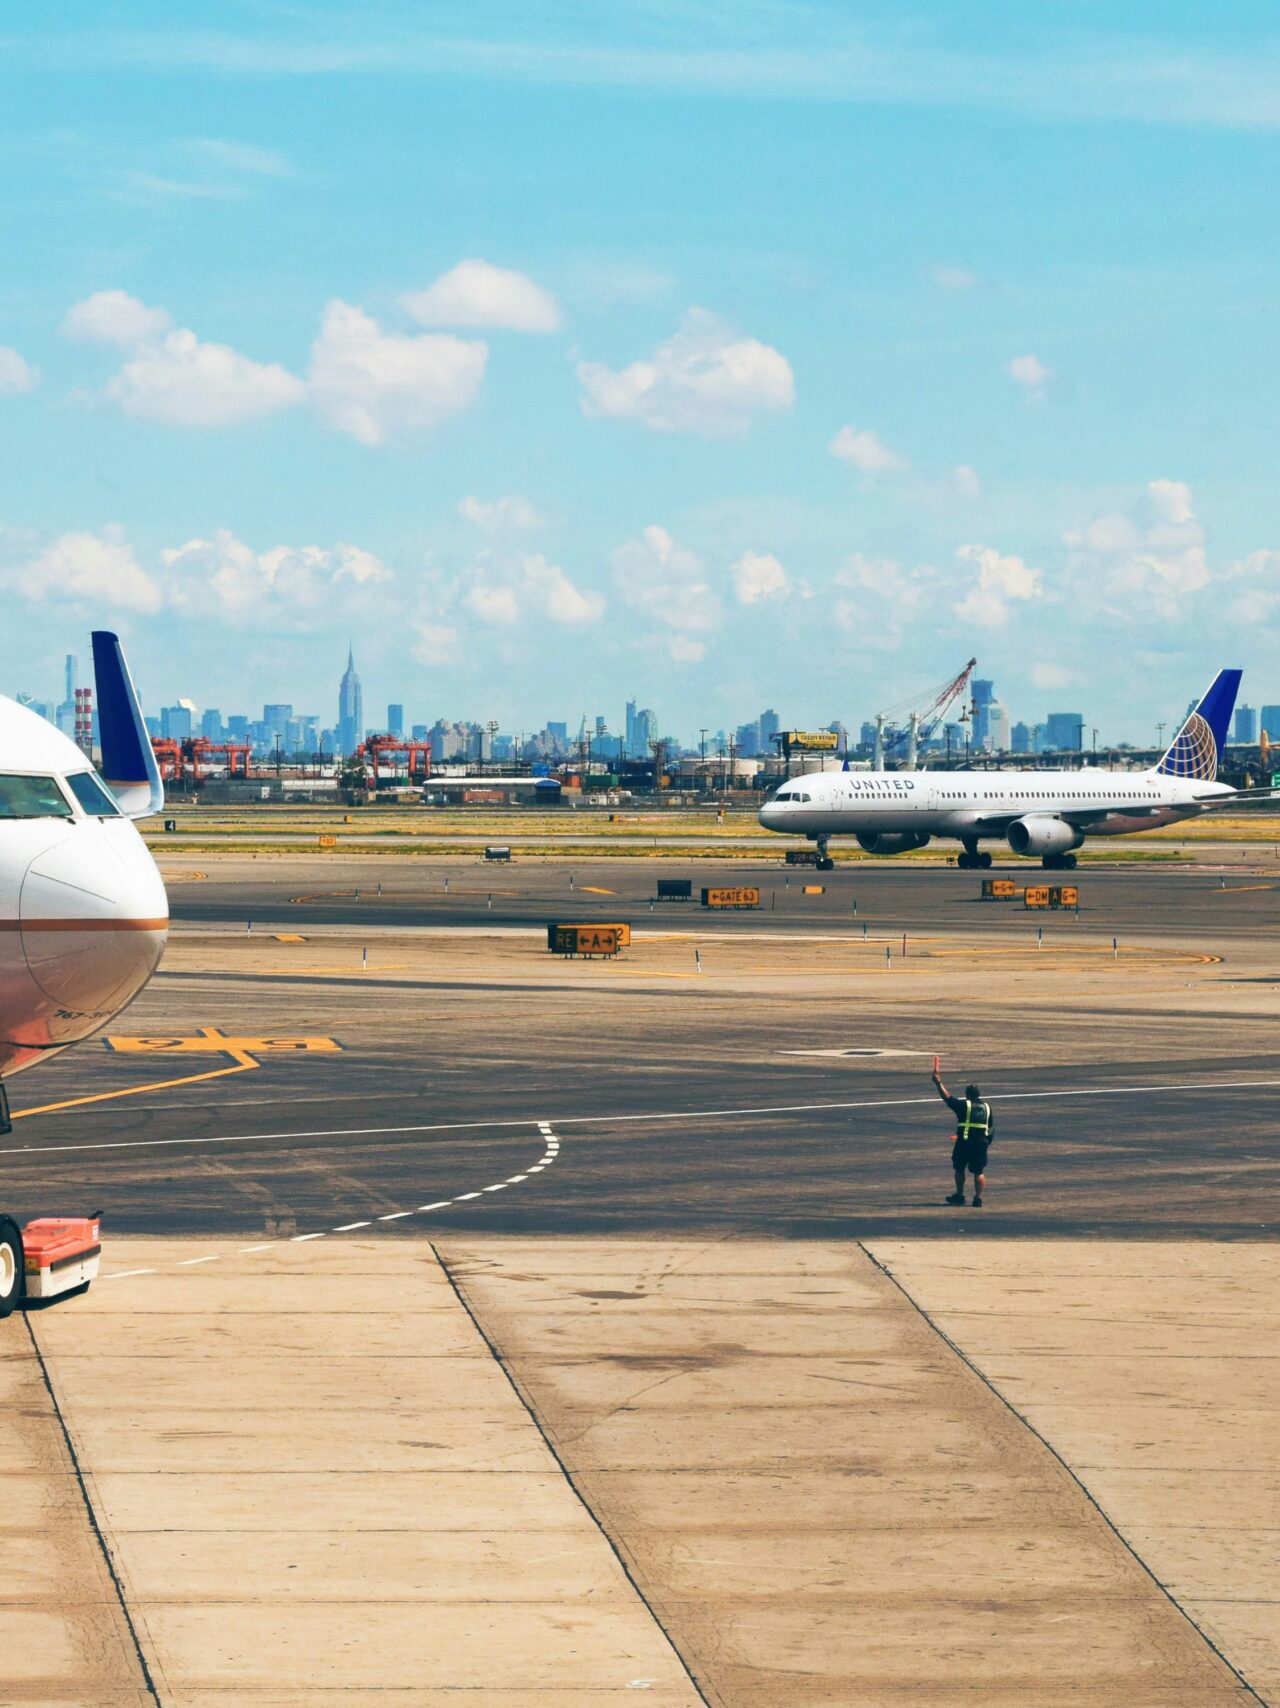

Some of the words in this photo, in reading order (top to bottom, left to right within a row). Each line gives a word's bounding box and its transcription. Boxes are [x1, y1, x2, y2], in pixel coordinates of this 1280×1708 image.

[850, 780, 914, 790] UNITED
[720, 892, 740, 901] GATE
[743, 891, 755, 901] 63
[1052, 890, 1058, 900] A
[1062, 890, 1068, 901] G
[556, 932, 573, 948] RE
[592, 933, 601, 948] A
